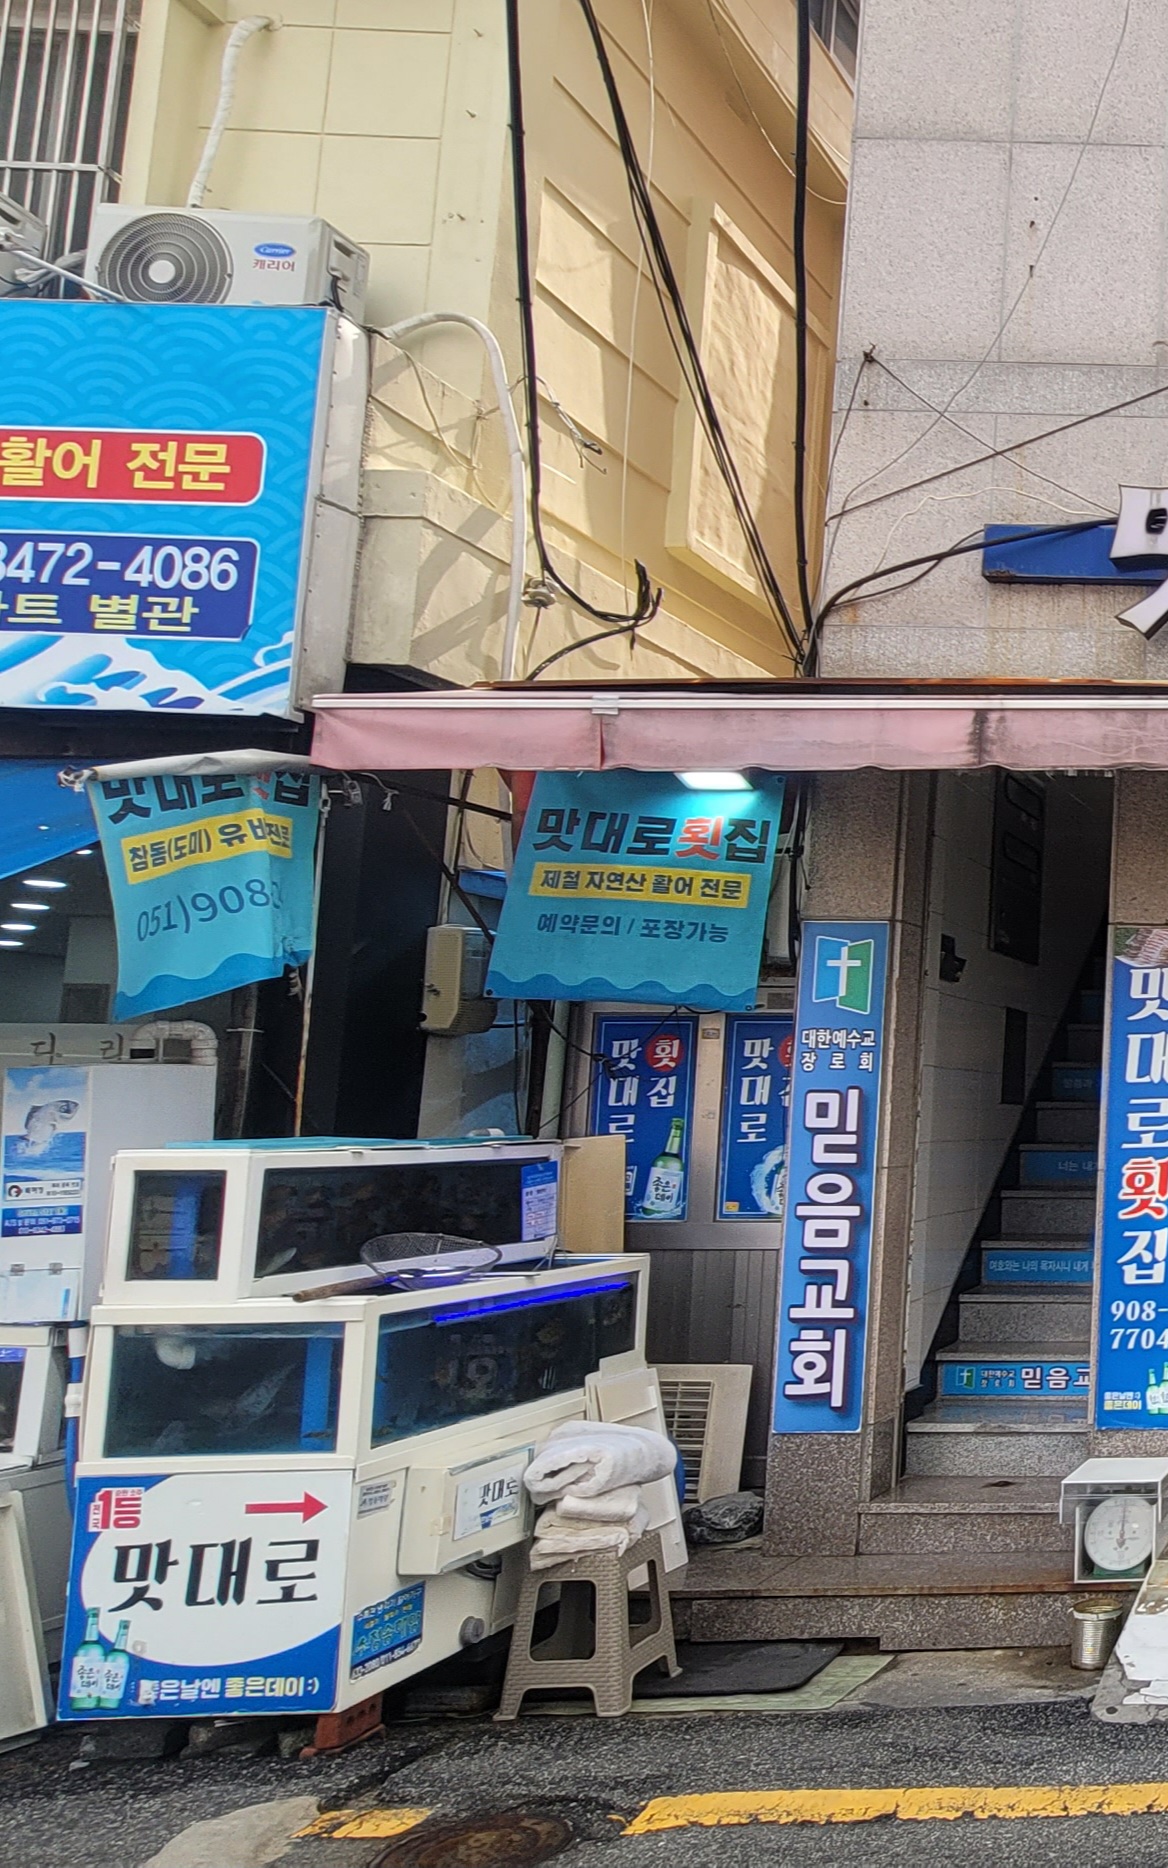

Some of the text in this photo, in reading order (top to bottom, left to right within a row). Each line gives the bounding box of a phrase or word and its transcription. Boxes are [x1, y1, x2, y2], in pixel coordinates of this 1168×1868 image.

[252, 259, 296, 272] 캐리어
[0, 436, 232, 492] 활어 전문
[0, 592, 199, 632] 트 별관
[129, 828, 212, 873] 참돔(도미)
[532, 808, 772, 864] 맛대로횟집
[540, 869, 742, 900] 제철 자연산 활어 전문
[536, 912, 622, 936] 예약문의
[638, 917, 730, 943] 포장가능
[801, 1028, 876, 1048] 대한예수교
[646, 1038, 681, 1108] 횟집
[801, 1051, 874, 1073] 장로회
[736, 1038, 775, 1143] 맛대로
[784, 1085, 862, 1411] 믿음교회
[107, 1537, 320, 1613] 맛대로
[225, 1677, 304, 1698] 좋은데이
